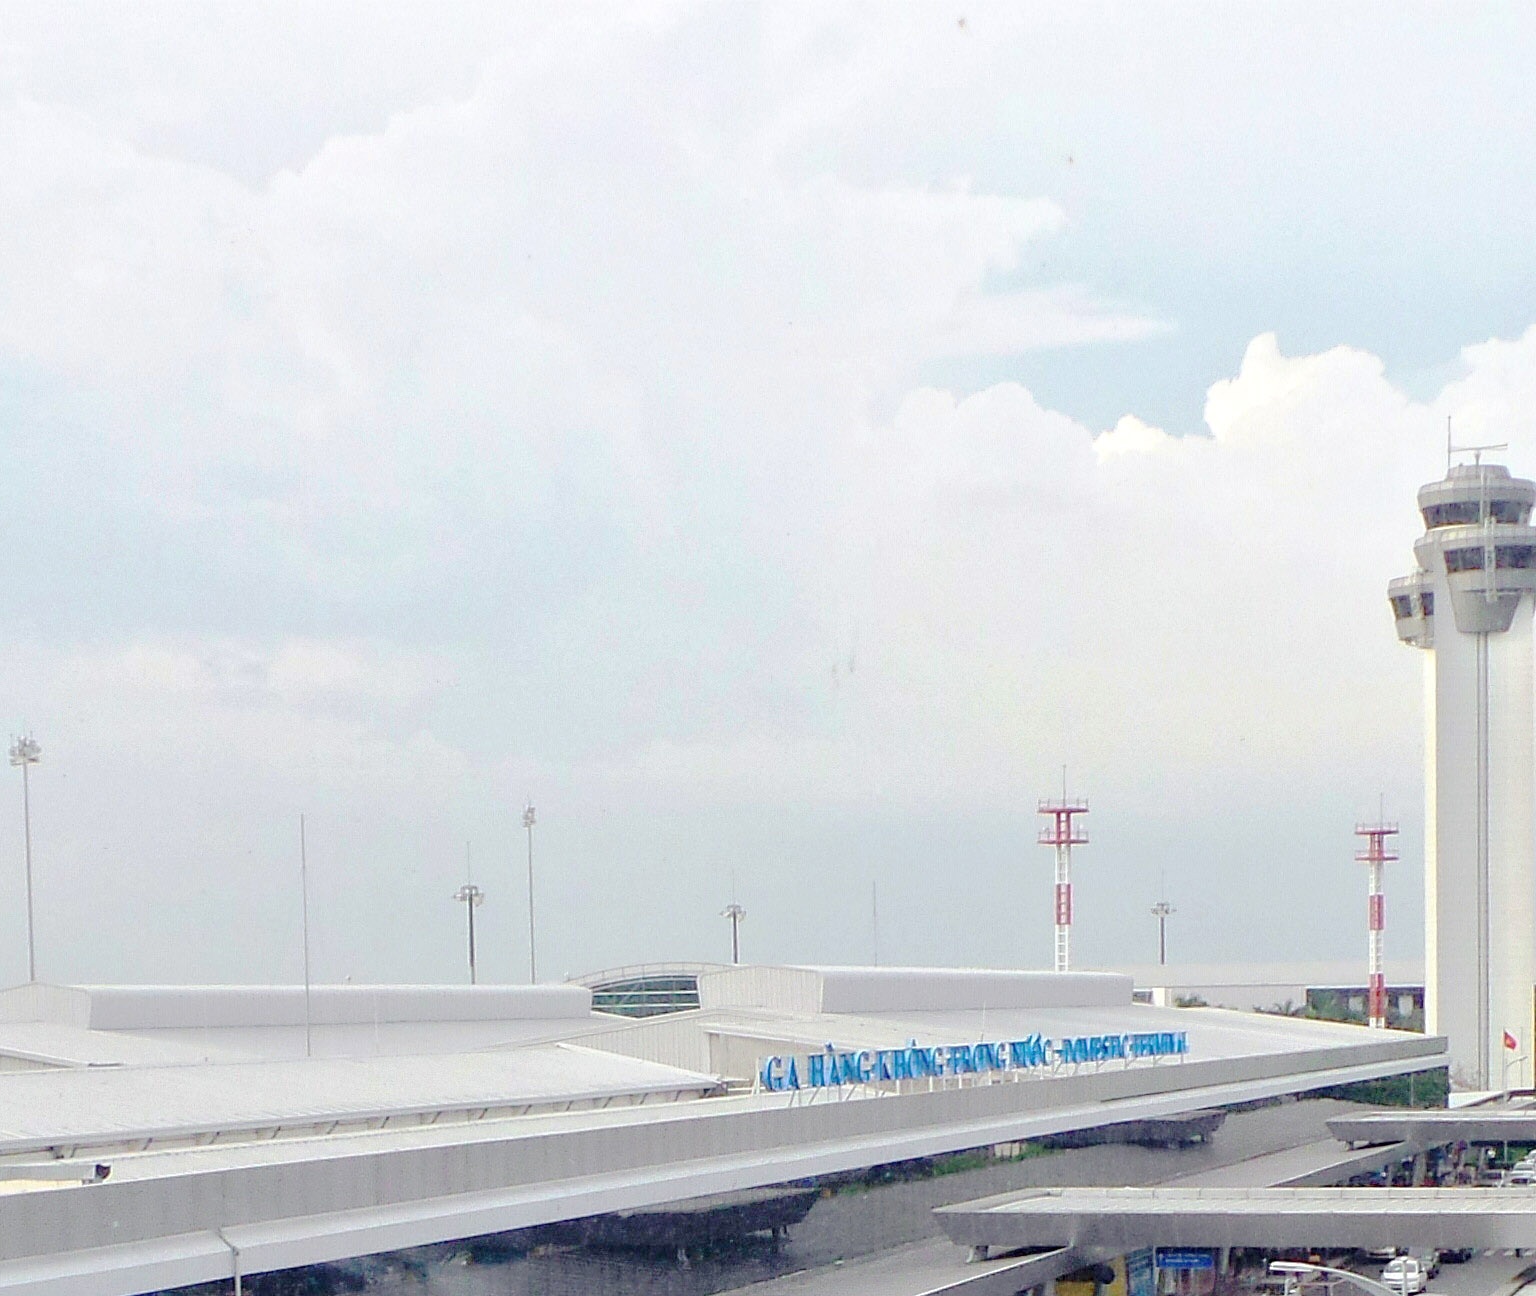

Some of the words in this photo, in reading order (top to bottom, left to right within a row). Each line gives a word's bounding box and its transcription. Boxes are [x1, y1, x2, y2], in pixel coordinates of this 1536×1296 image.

[764, 1055, 801, 1092] GA
[808, 1040, 870, 1087] HÀNG
[874, 1039, 944, 1081] KHÔNG
